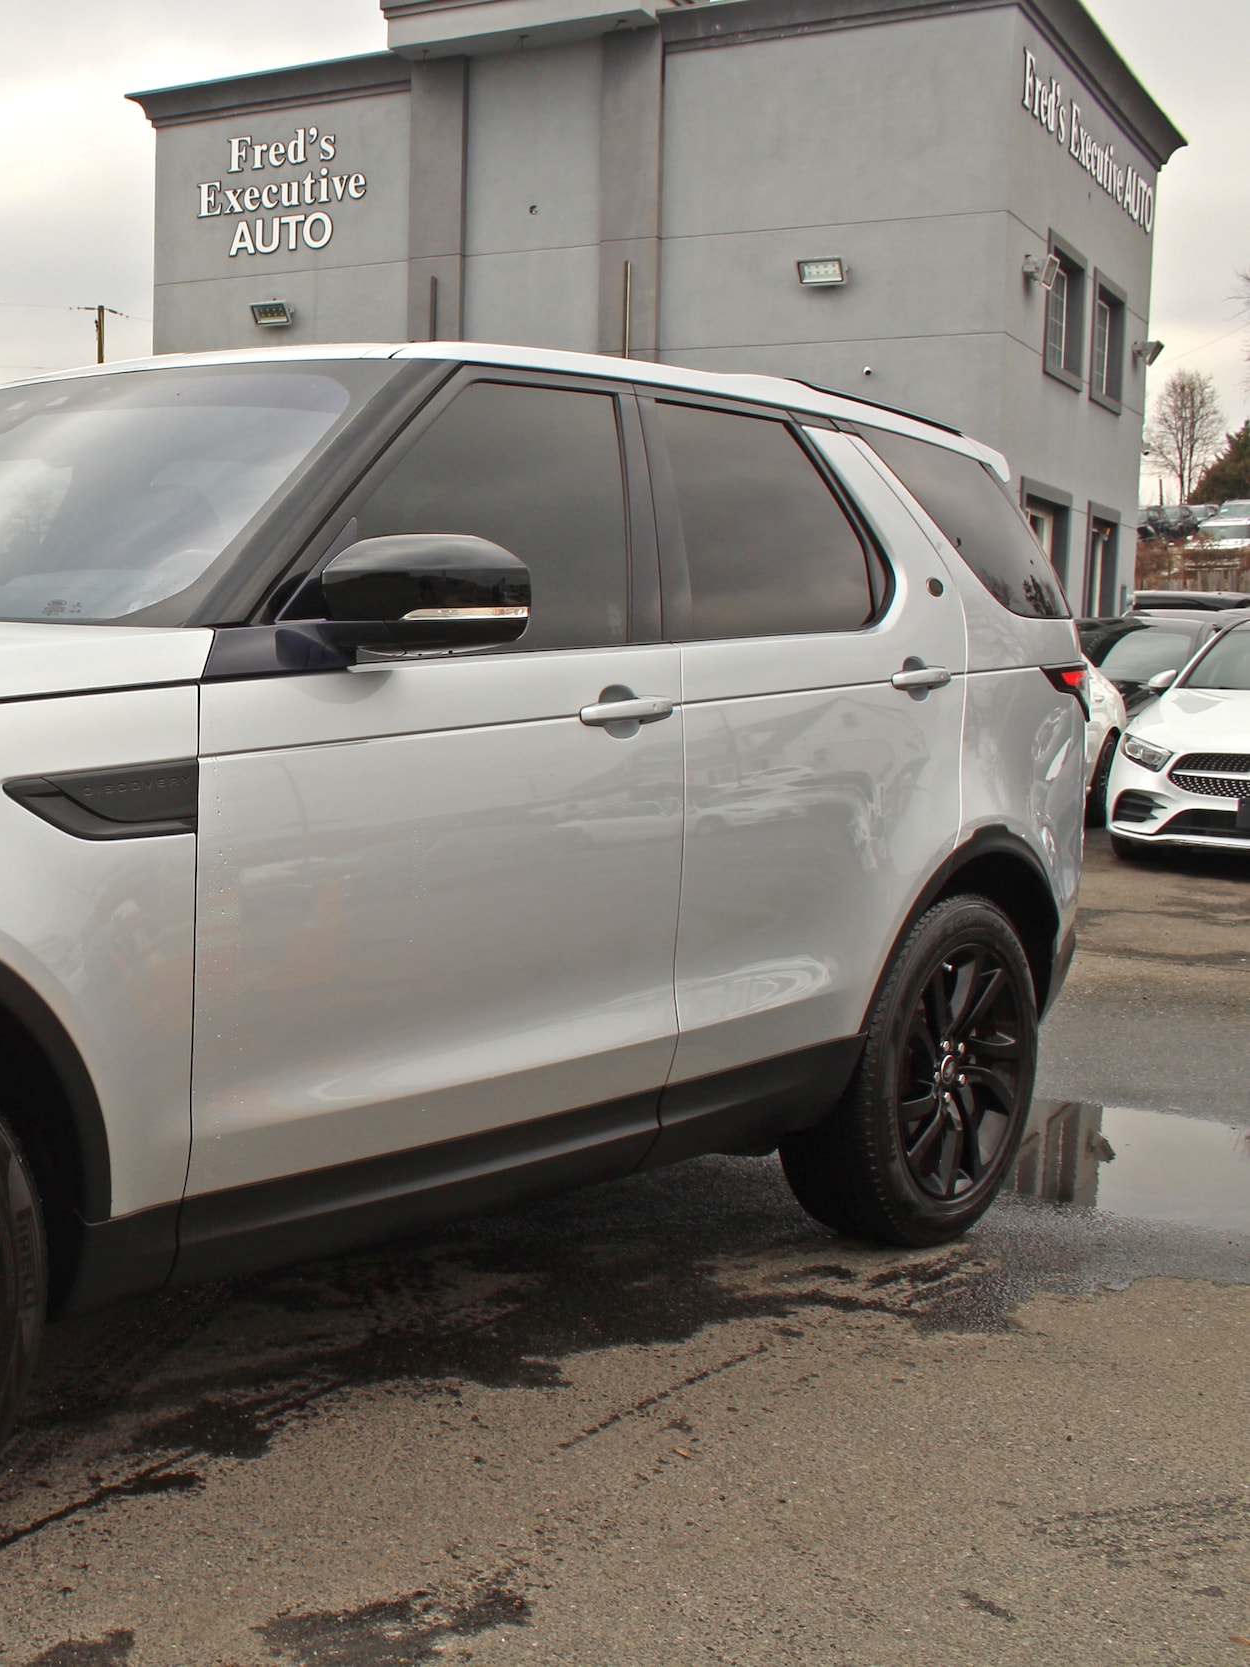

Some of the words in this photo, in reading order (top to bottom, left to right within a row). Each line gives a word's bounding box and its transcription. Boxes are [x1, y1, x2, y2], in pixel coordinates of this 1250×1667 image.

[227, 127, 336, 173] Fred's
[1023, 46, 1066, 144] Fred's
[1069, 99, 1124, 204] Executive
[1123, 165, 1153, 233] AUTO
[197, 167, 367, 218] Executive
[228, 211, 333, 257] AUTO
